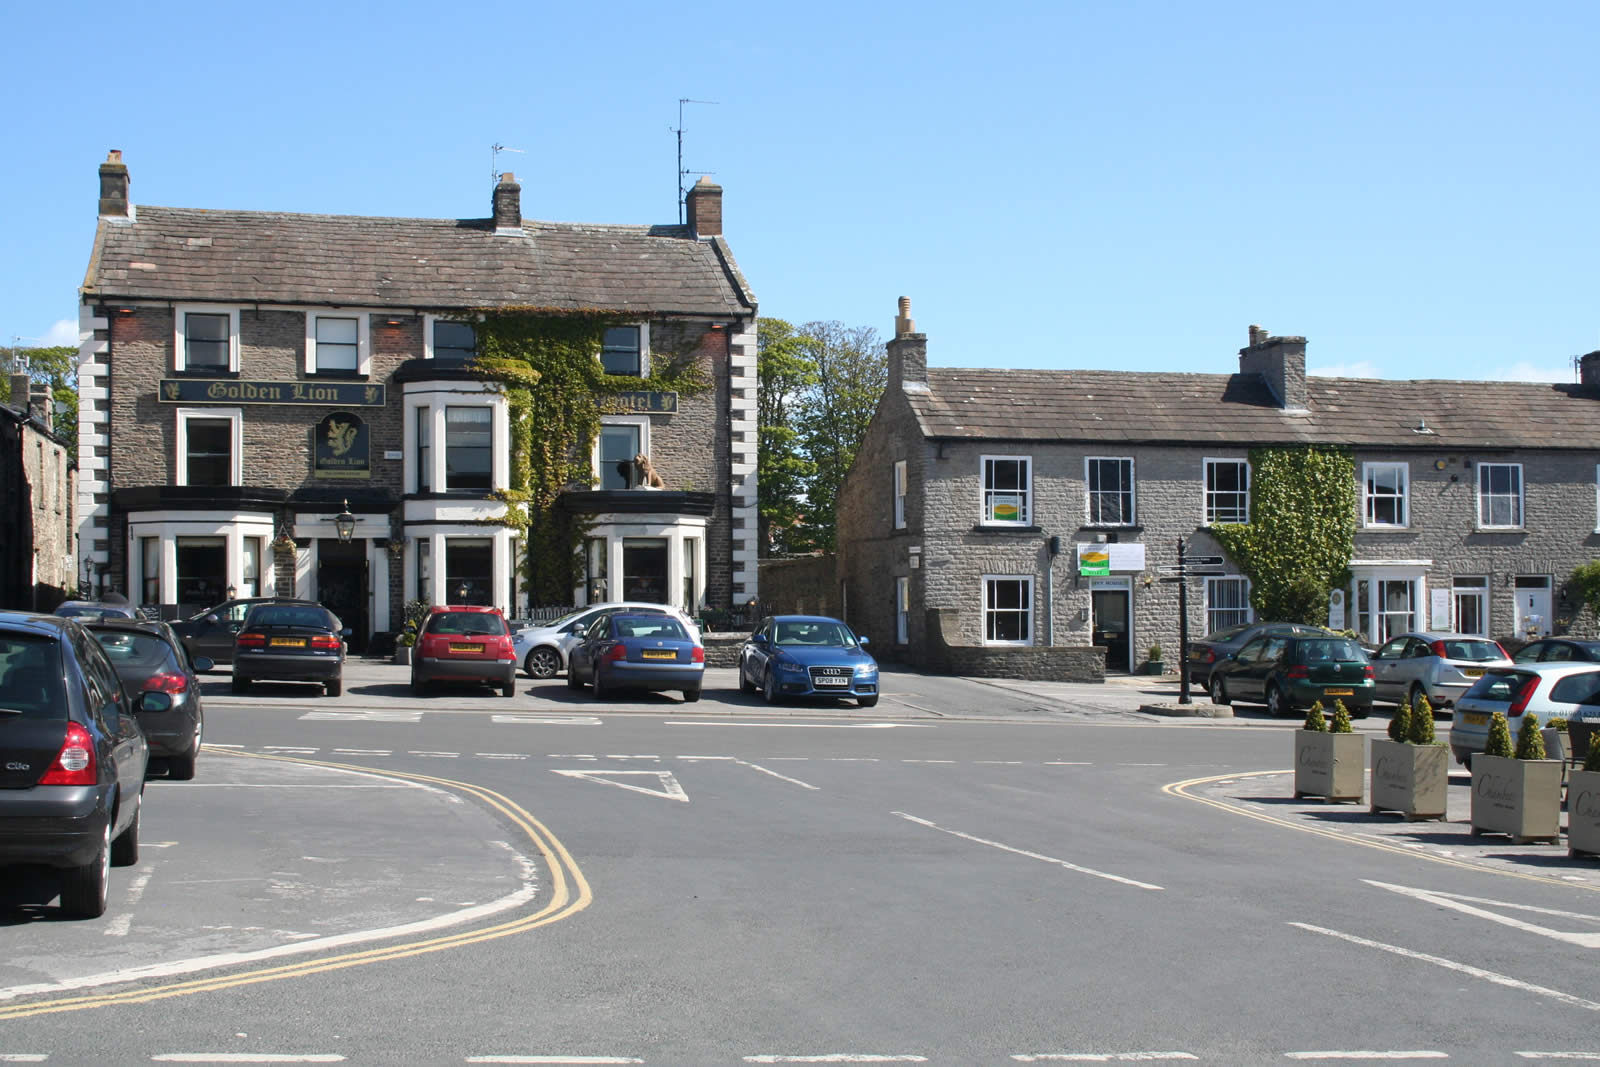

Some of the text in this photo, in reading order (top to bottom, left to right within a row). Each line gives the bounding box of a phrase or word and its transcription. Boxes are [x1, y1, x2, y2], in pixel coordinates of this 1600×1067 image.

[207, 382, 339, 401] Golden Lion
[6, 762, 29, 770] Clio
